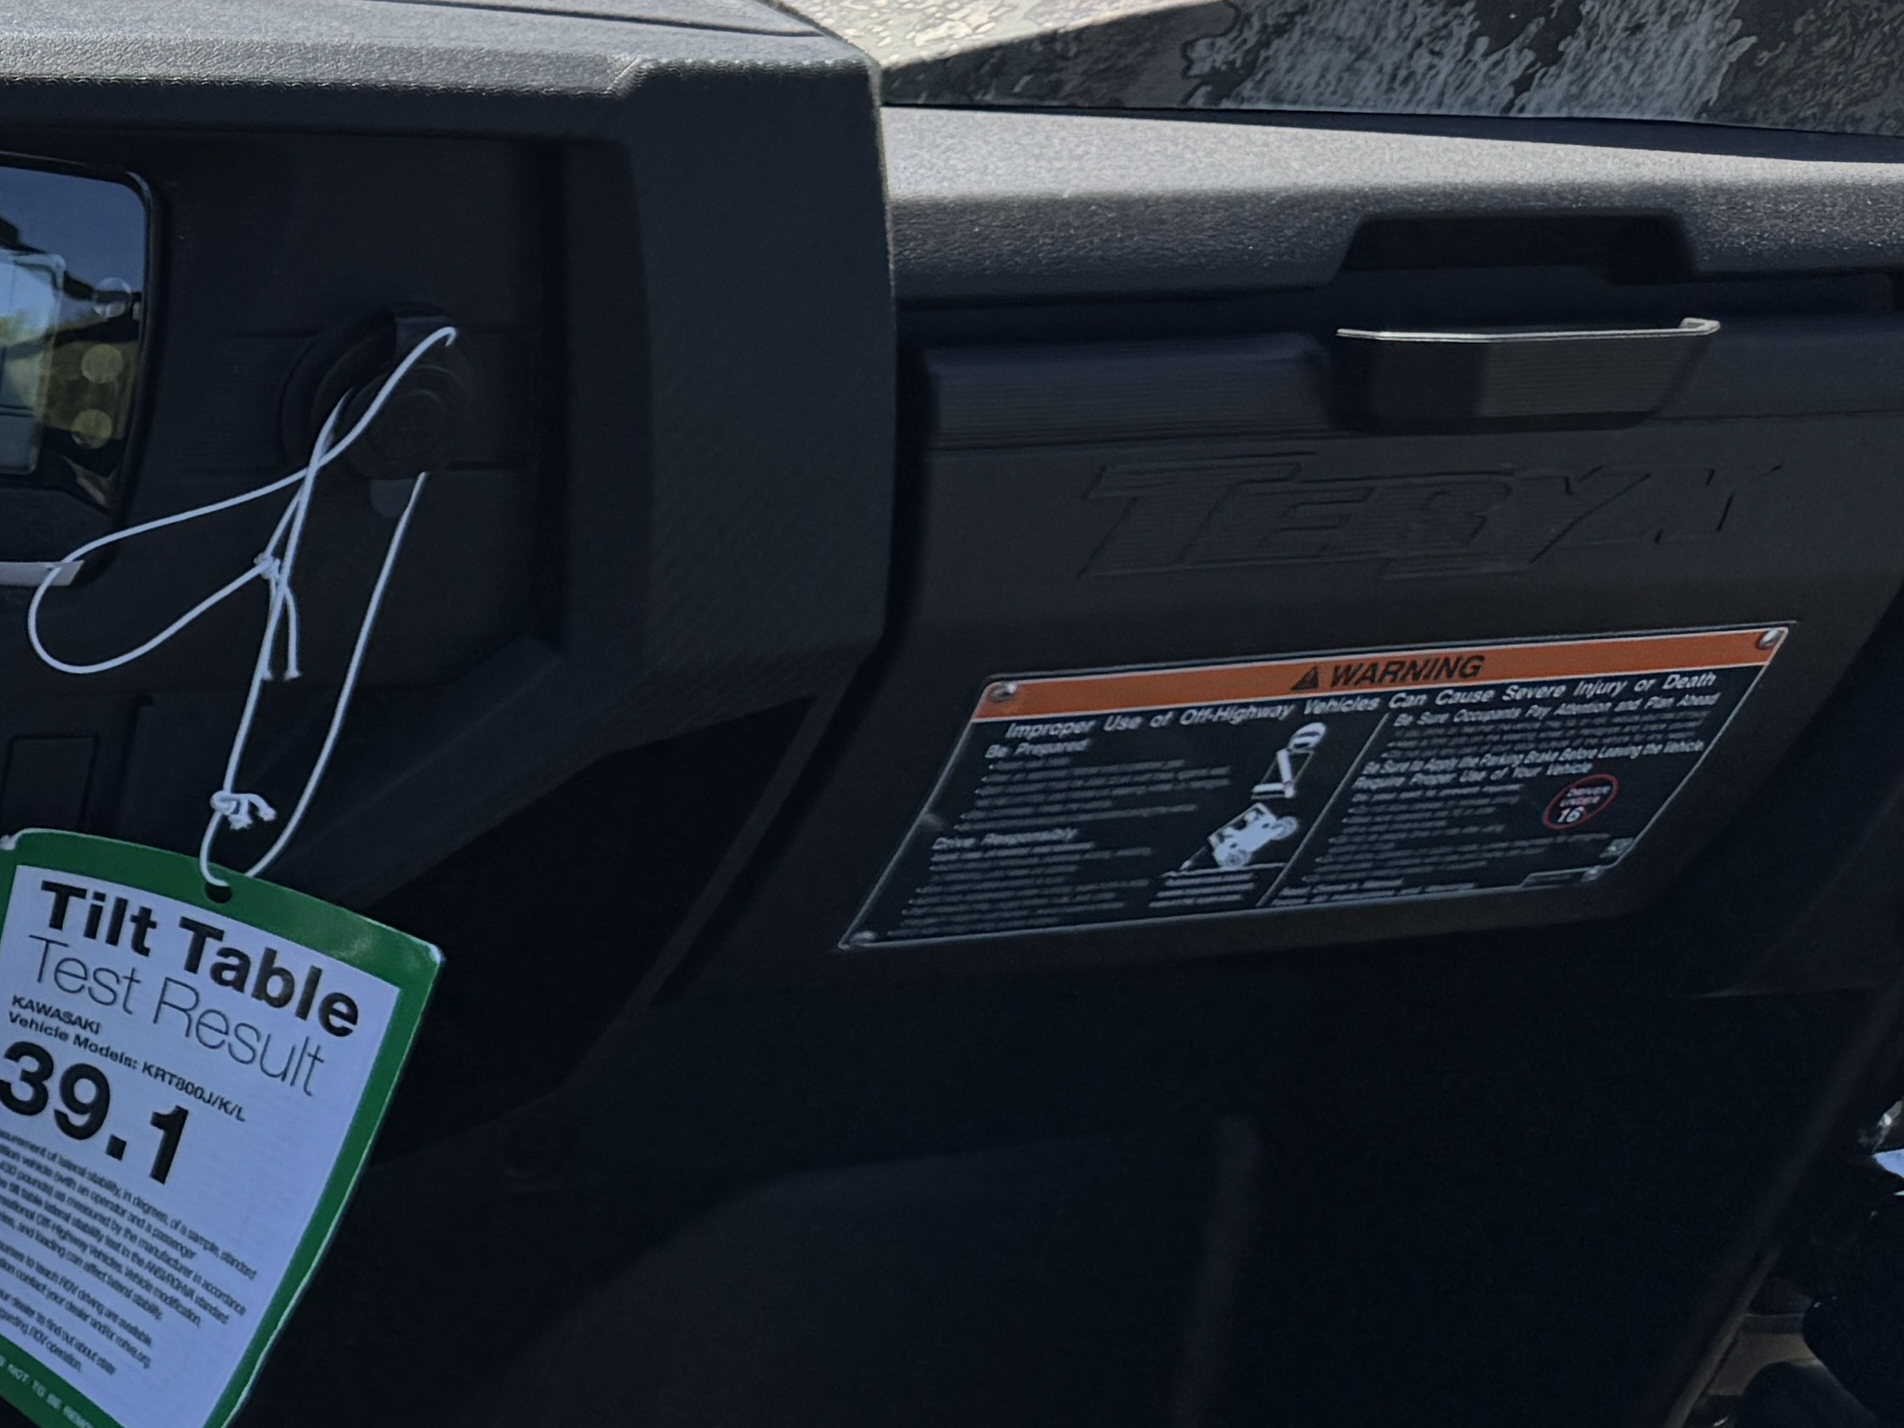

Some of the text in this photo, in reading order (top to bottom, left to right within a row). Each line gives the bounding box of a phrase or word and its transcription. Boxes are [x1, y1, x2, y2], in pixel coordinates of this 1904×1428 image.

[1330, 655, 1485, 688] WARNING
[1006, 672, 1716, 740] Improper Use of Off-Highway Vehicles Can Cause Severe Injury or Death
[41, 880, 359, 1038] Tilt Table
[9, 1011, 68, 1041] Vehicle
[73, 1034, 137, 1069] Models:
[12, 995, 100, 1034] KAWASAKI
[29, 935, 324, 1096] Test Result
